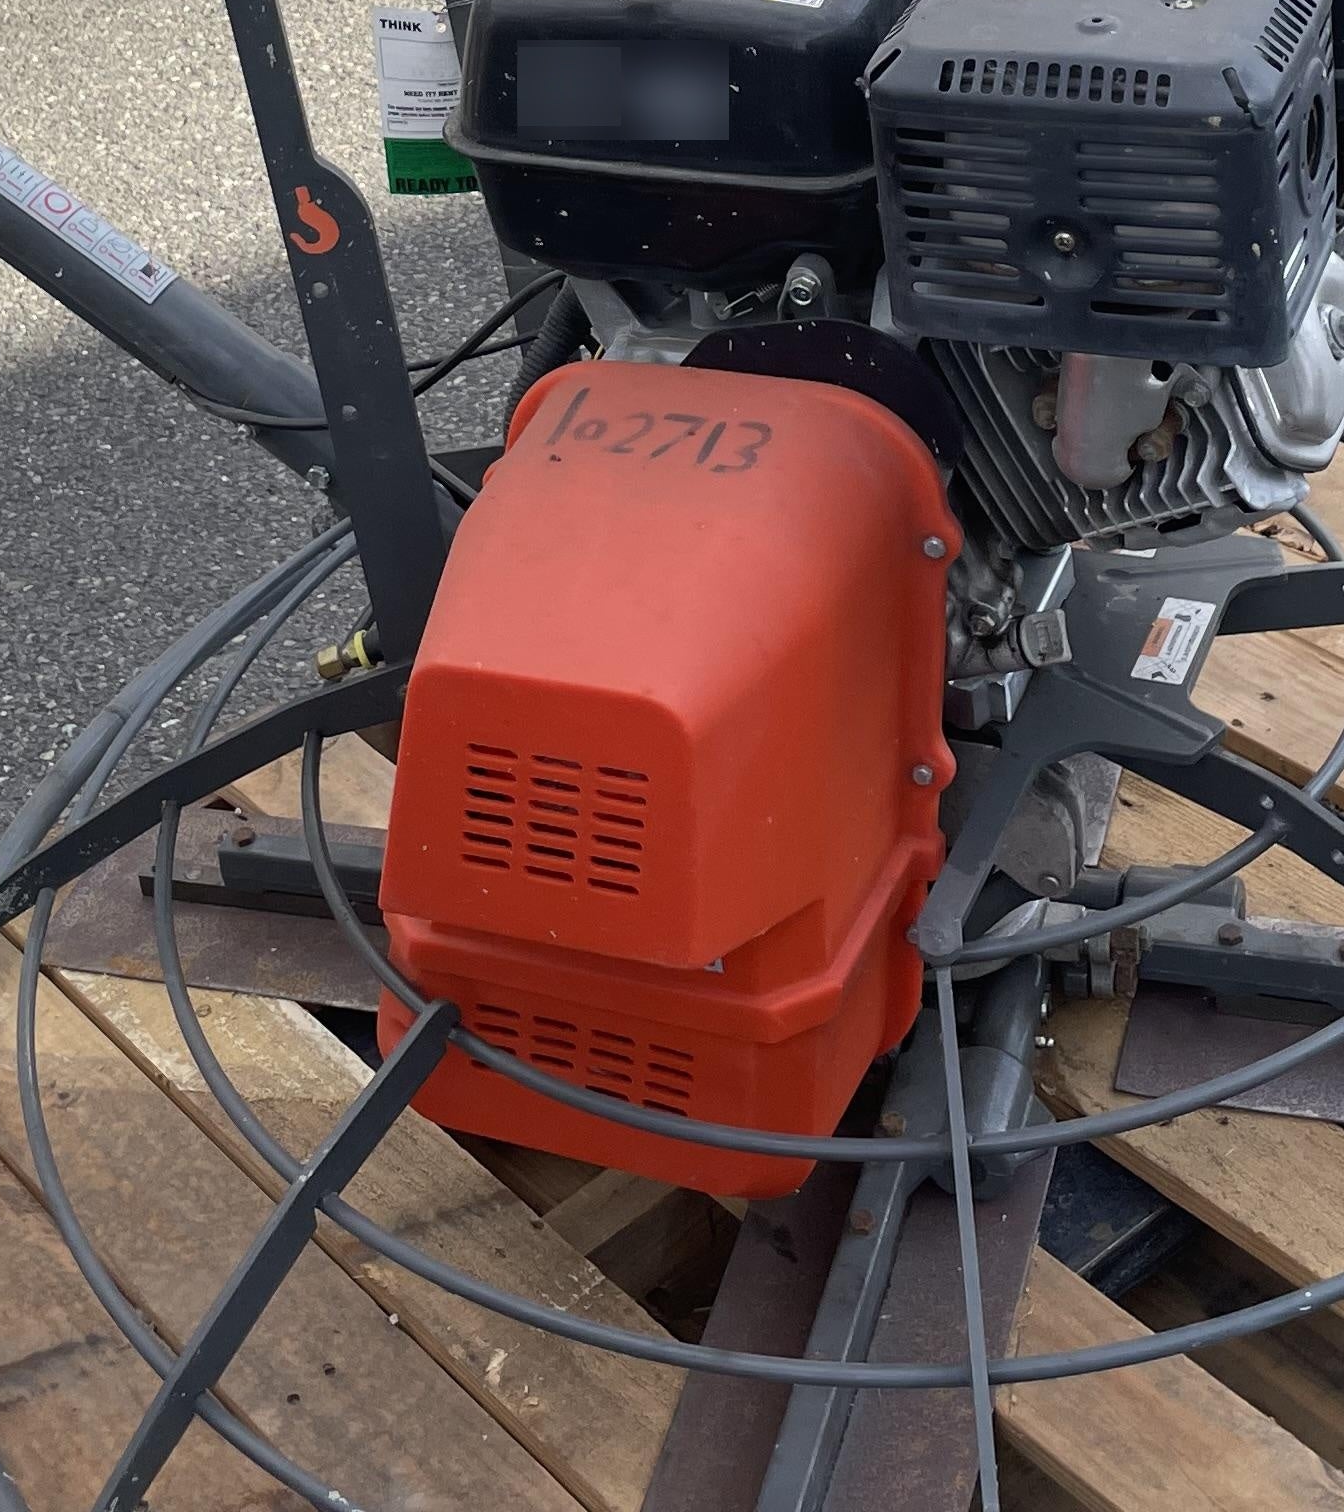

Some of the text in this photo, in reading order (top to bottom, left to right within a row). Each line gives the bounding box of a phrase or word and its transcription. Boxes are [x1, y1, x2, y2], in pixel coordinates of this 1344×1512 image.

[379, 18, 423, 33] THINK
[396, 177, 449, 192] READY
[545, 387, 773, 473] 102713
